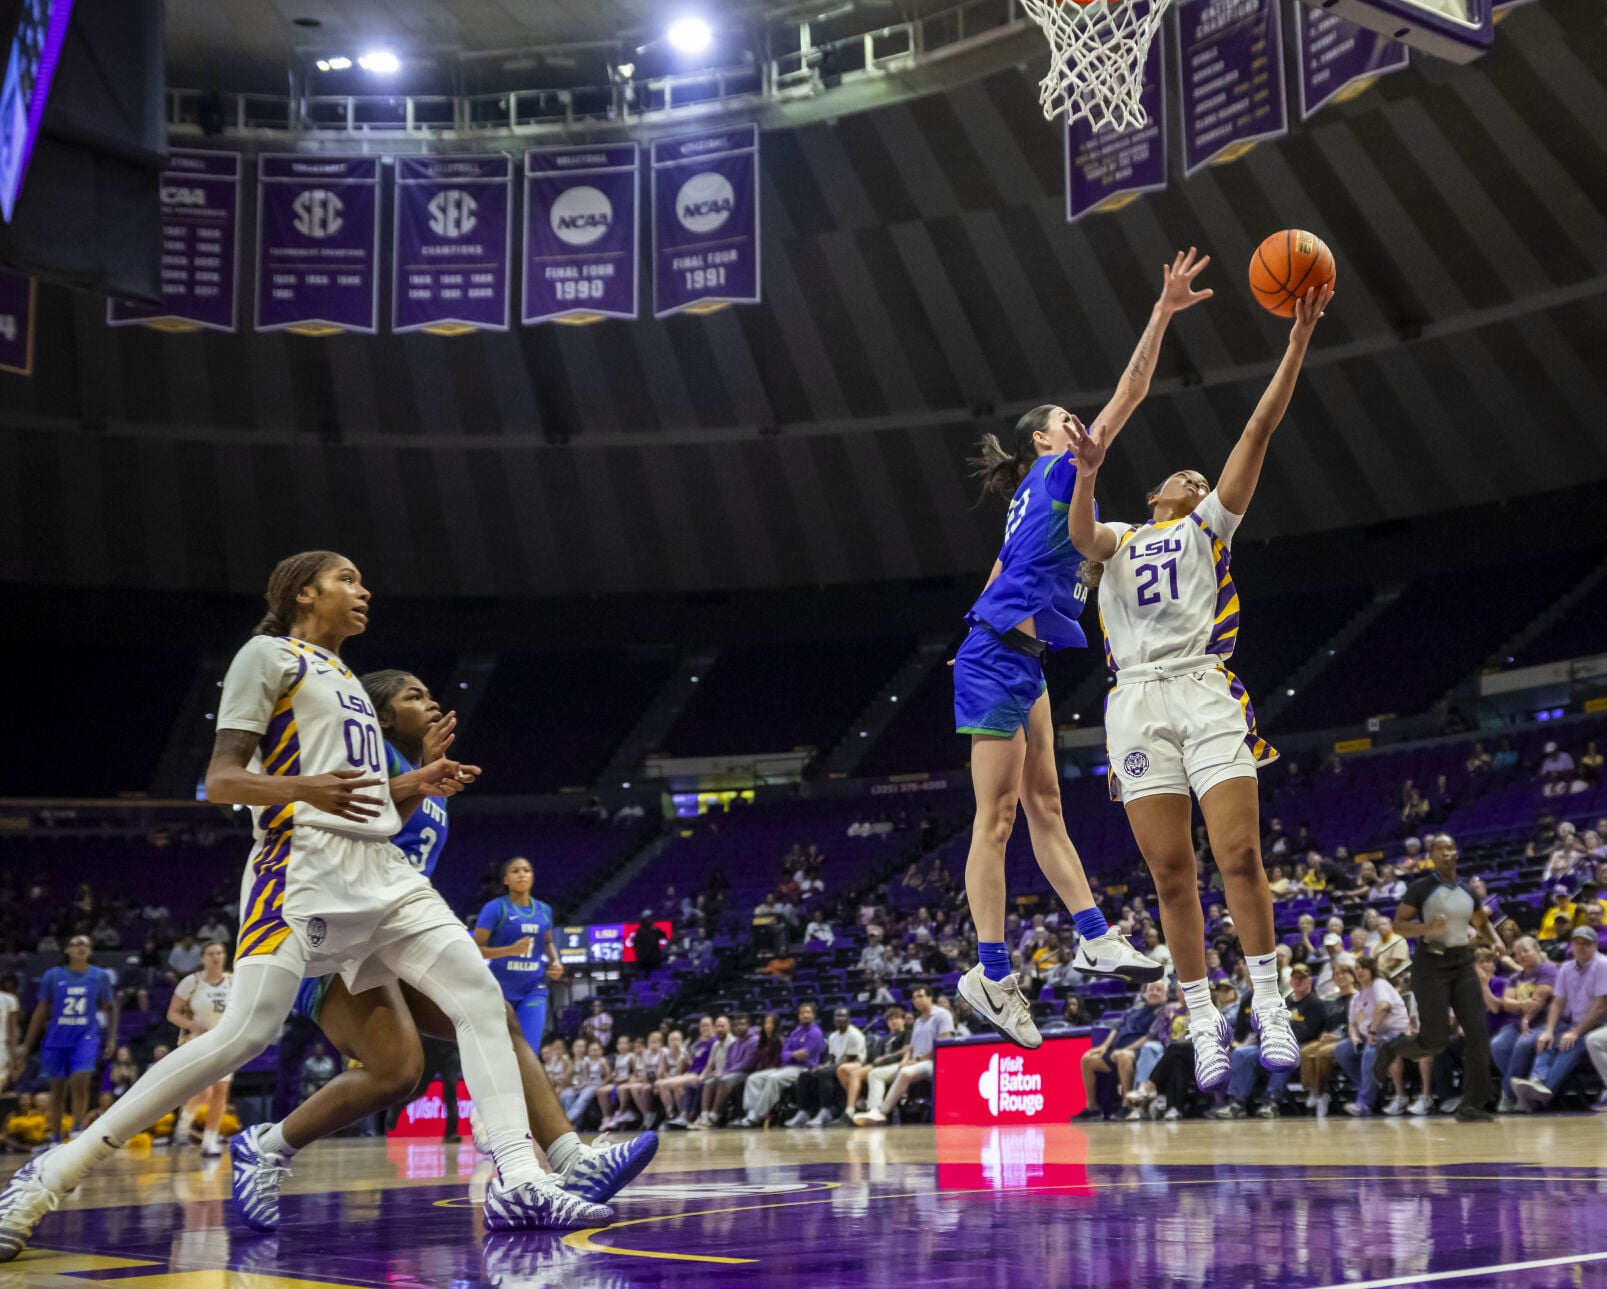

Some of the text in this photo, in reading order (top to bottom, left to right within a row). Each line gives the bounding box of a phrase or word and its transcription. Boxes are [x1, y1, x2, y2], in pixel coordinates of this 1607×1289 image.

[292, 189, 344, 238] SEC
[427, 190, 478, 238] SEC
[683, 198, 731, 218] NCAA
[557, 213, 609, 229] NCAA
[421, 245, 483, 255] CHAMPIONS
[673, 249, 739, 270] FINAL FOUR
[545, 264, 615, 279] FINAL FOUR
[685, 266, 727, 291] 1991
[555, 279, 604, 301] 1990
[1130, 538, 1182, 560] LSU
[1135, 557, 1180, 607] 21
[336, 690, 376, 719] LSU
[344, 717, 380, 773] 00
[422, 796, 448, 828] UNT
[410, 826, 438, 873] 3
[521, 923, 540, 934] UNT
[595, 928, 619, 939] LSU
[63, 996, 87, 1016] 24
[211, 999, 227, 1014] 15
[1000, 1055, 1025, 1073] Visit
[999, 1072, 1042, 1092] Baton
[999, 1092, 1045, 1117] Rouge
